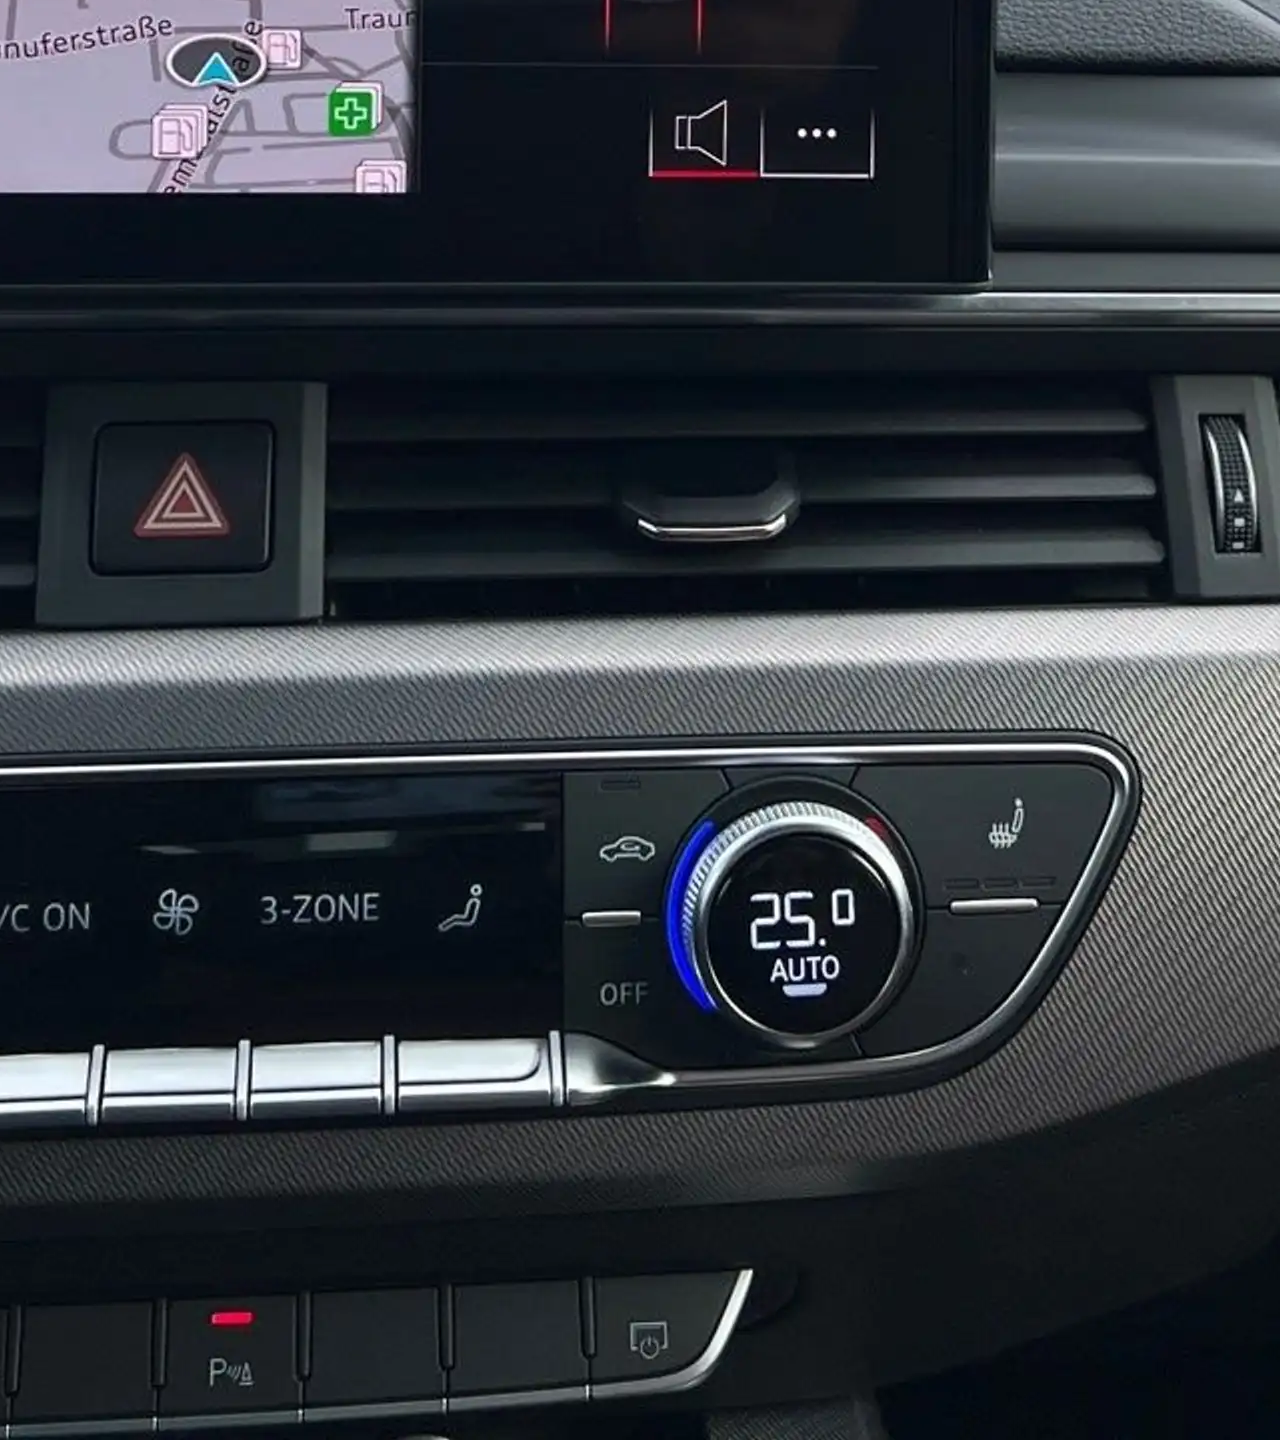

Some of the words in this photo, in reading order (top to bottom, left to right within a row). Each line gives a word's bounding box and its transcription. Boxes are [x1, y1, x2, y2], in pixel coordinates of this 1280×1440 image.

[44, 902, 90, 931] ON
[260, 892, 380, 925] 3-ZONE
[750, 889, 855, 949] 25.0
[770, 955, 840, 983] AUTO
[600, 982, 648, 1006] OFF
